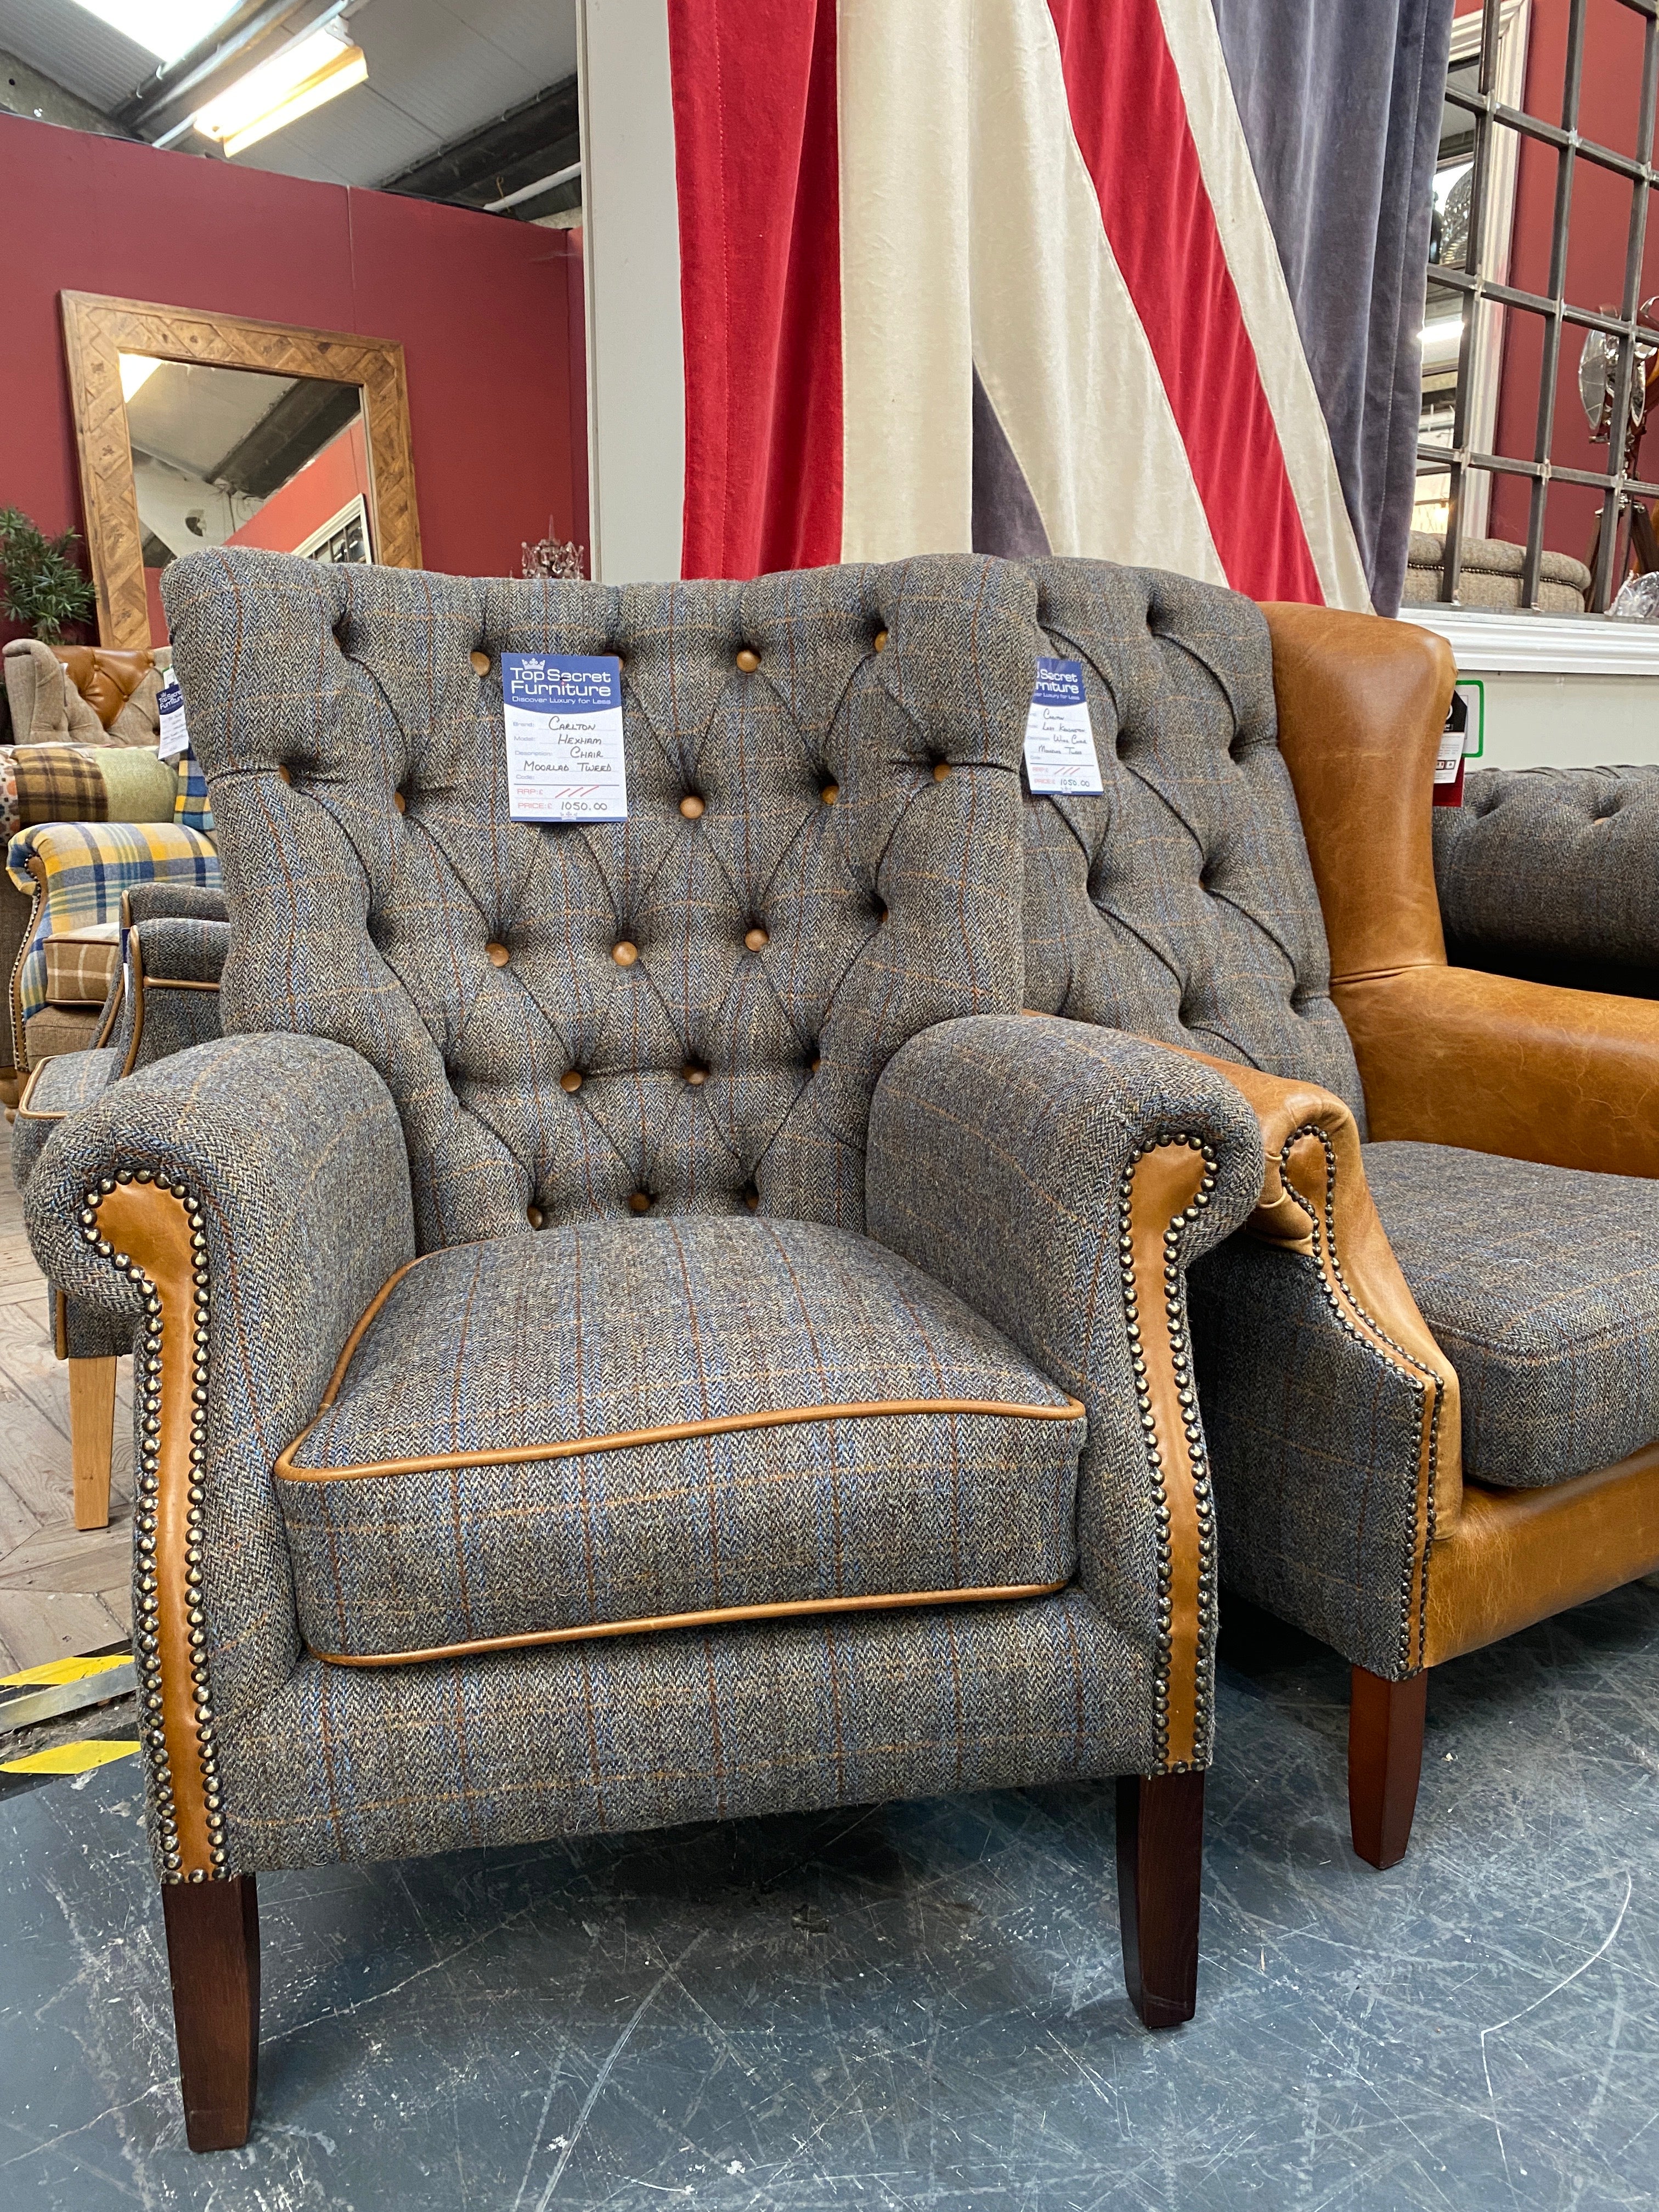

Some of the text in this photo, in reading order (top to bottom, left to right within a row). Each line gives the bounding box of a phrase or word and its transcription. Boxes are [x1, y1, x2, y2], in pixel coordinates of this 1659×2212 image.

[510, 667, 611, 682] Top Secret
[1040, 668, 1078, 682] Secret
[511, 680, 611, 697] Furniture
[1035, 681, 1080, 694] rniture
[549, 697, 576, 705] Luxury
[577, 762, 612, 772] TWEED
[1060, 778, 1090, 787] 1050.00
[561, 801, 608, 811] 1050.00
